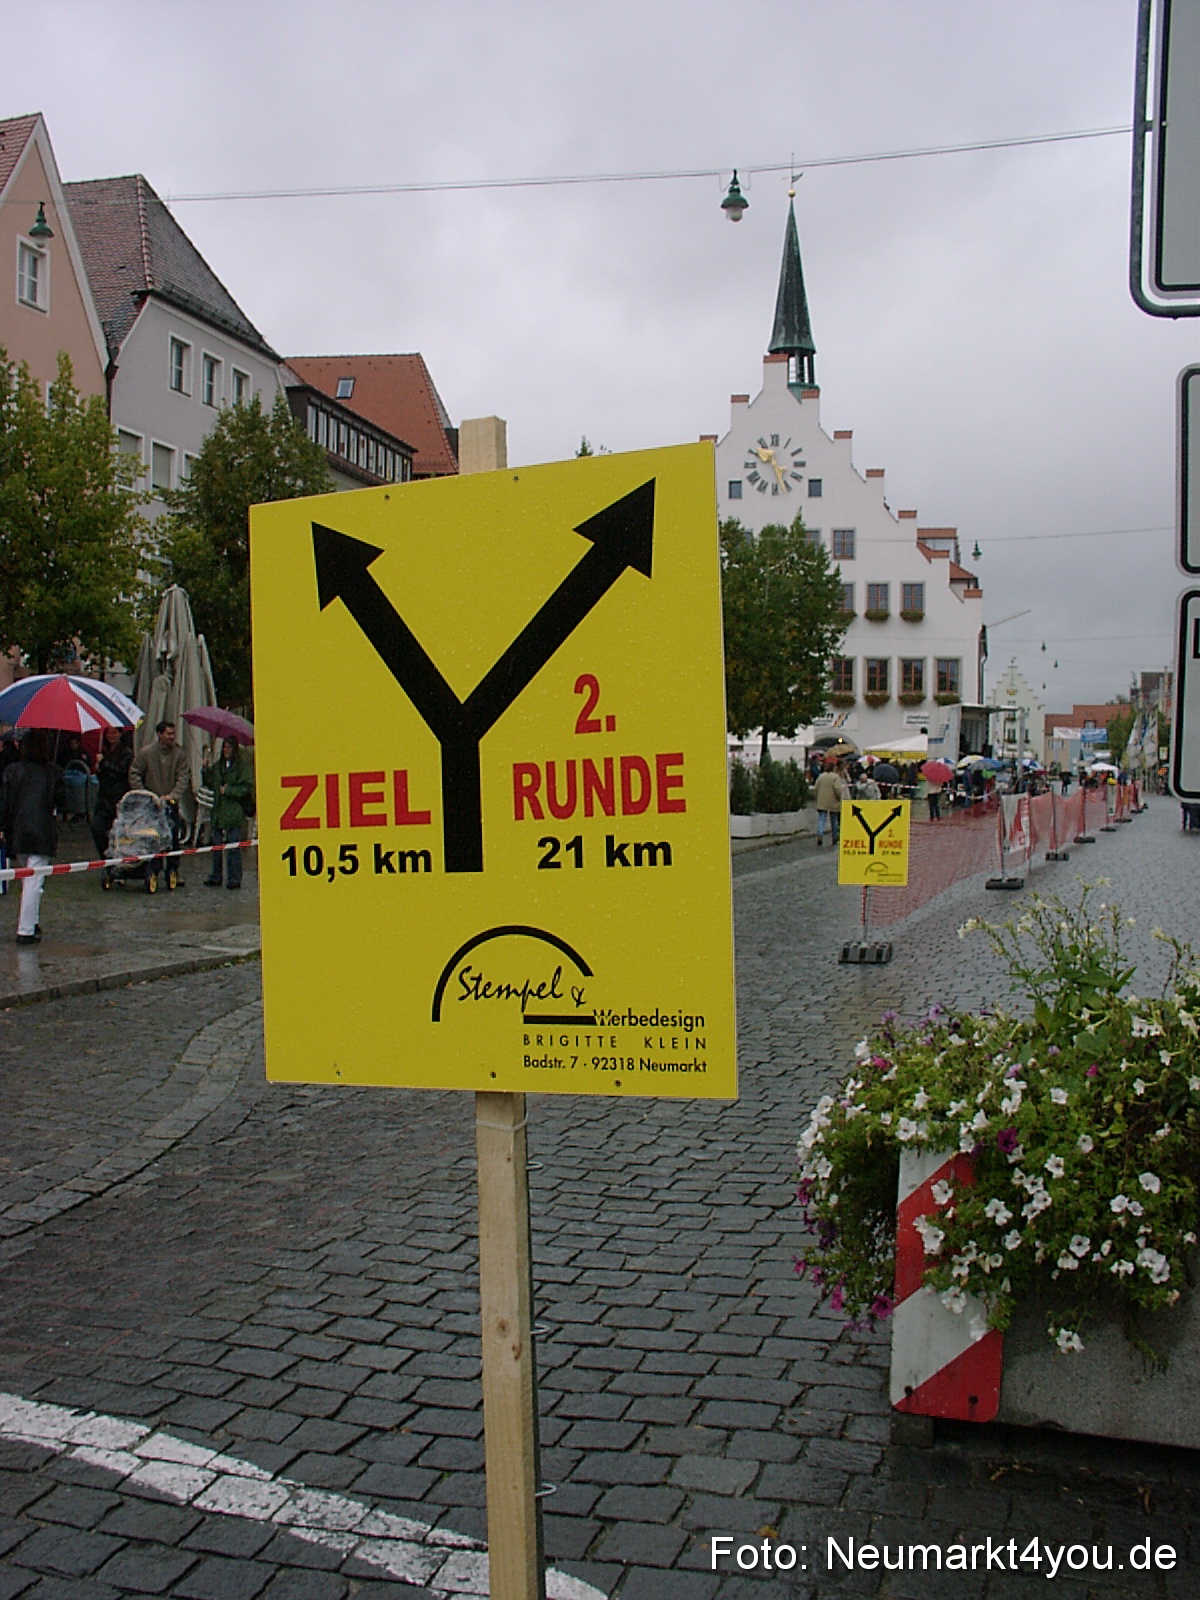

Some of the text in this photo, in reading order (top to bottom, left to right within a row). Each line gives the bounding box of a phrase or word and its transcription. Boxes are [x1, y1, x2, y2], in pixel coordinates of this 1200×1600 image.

[573, 673, 616, 735] 2.
[279, 769, 432, 831] ZIEL
[512, 752, 687, 821] RUNDE
[537, 834, 673, 870] 21 km
[843, 839, 867, 848] ZIEL
[281, 843, 433, 883] 10,5 km
[457, 965, 563, 1013] Stempel
[593, 1007, 706, 1033] Werbedesign
[523, 1033, 707, 1050] BRIGITTE KLEIN
[523, 1054, 567, 1070] Badstr.
[570, 1056, 579, 1069] 7
[591, 1057, 635, 1071] 92318
[639, 1057, 707, 1073] Neumarkt
